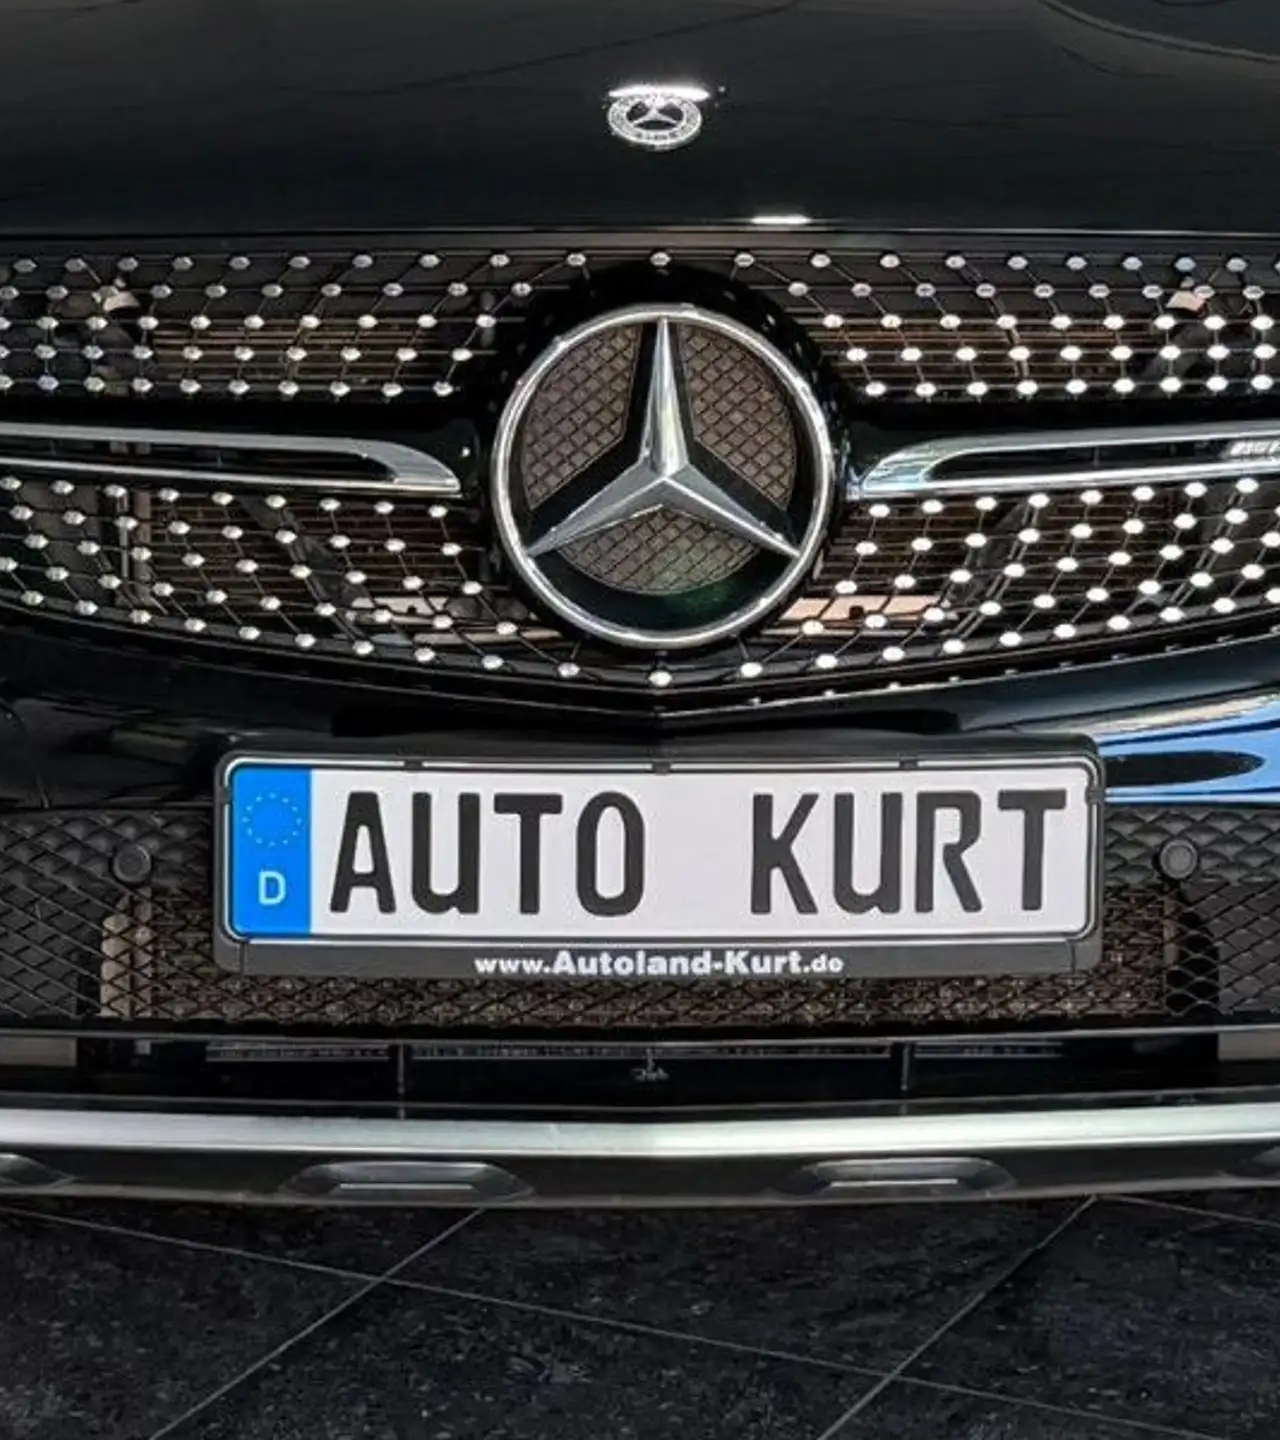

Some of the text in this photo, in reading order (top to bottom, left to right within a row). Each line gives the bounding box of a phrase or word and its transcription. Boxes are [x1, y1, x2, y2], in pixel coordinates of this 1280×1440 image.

[329, 789, 1067, 917] AUTO KURT
[258, 870, 287, 906] D
[474, 948, 845, 977] www.Autoland-Kurt.de
